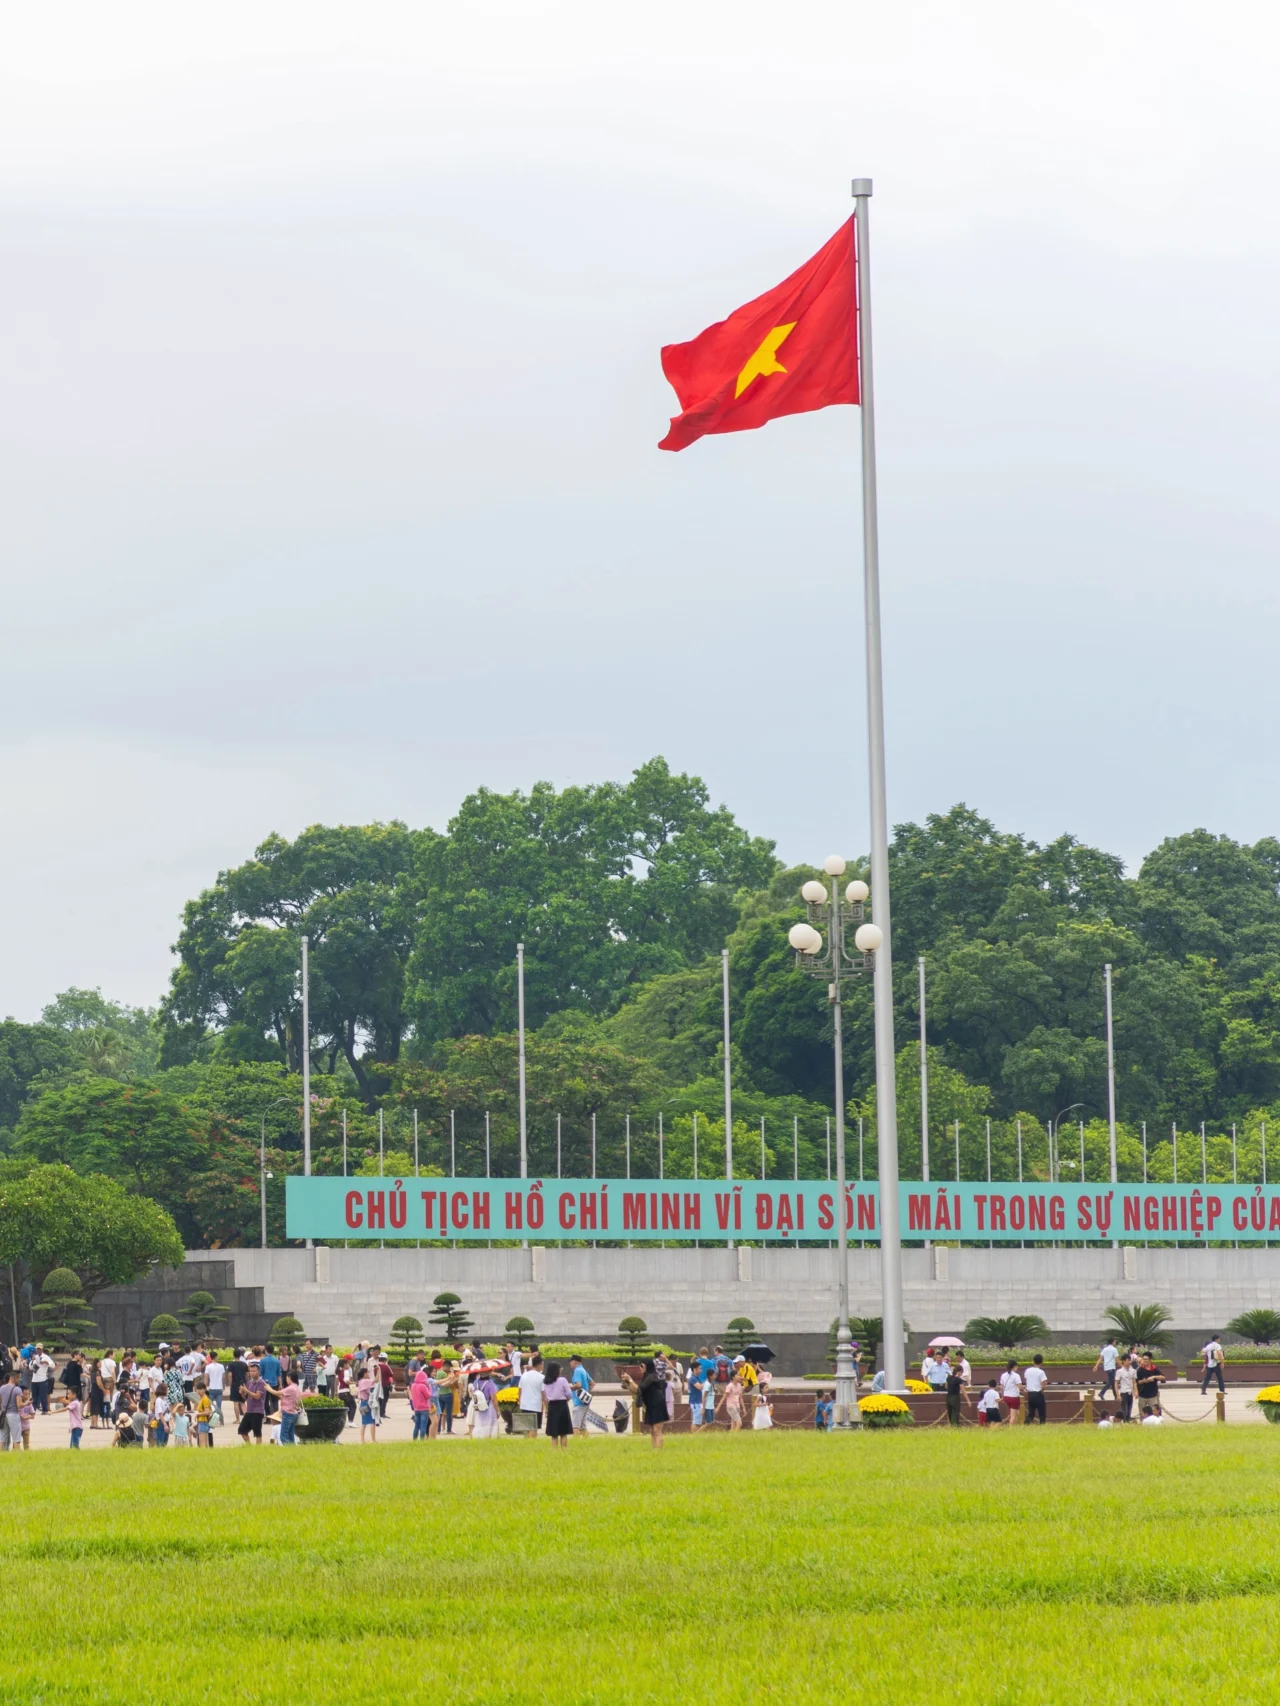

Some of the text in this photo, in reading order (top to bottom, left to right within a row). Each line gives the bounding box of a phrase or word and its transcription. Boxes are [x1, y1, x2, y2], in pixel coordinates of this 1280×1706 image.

[345, 1180, 407, 1229] CHỦ
[421, 1191, 491, 1237] TỊCH
[505, 1181, 544, 1230] HỒ
[558, 1184, 608, 1230] CHÍ
[623, 1192, 701, 1230] MINH
[714, 1186, 743, 1231] VĨ
[755, 1193, 805, 1238] ĐẠI
[818, 1183, 880, 1230] SỐN
[908, 1187, 962, 1231] MÃI
[974, 1194, 1066, 1231] TRONG
[1077, 1191, 1114, 1238] SỰ
[1123, 1189, 1222, 1238] NGHIỆP
